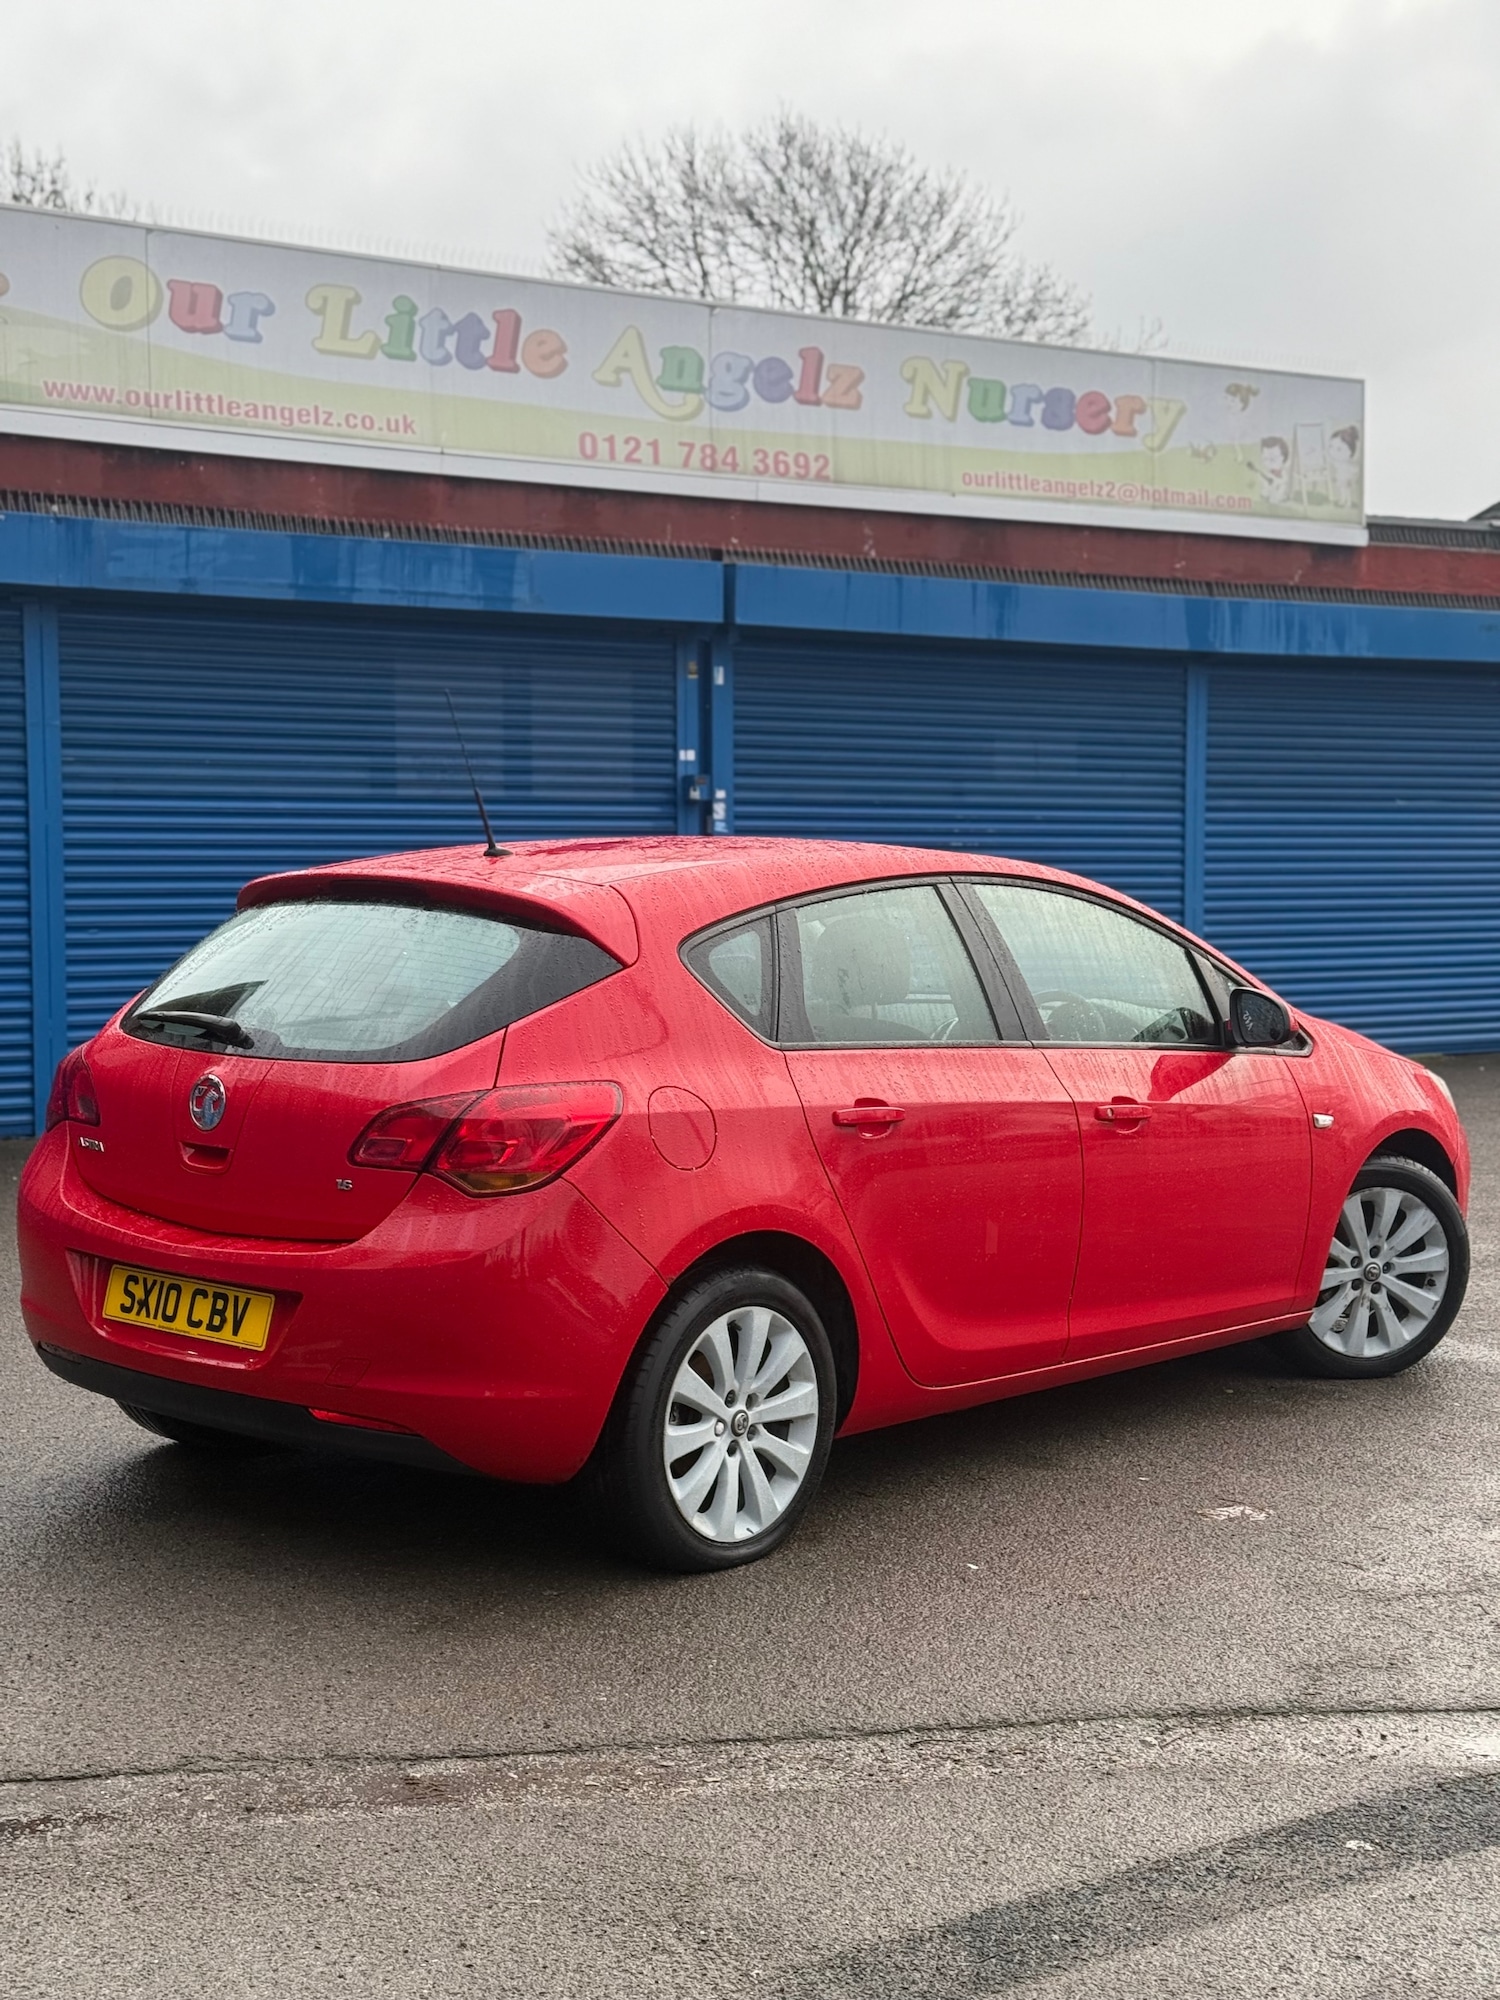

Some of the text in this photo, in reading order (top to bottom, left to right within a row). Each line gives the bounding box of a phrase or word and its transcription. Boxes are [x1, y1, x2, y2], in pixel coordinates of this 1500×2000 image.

[80, 255, 1186, 451] Our Little Angelz Nursery
[43, 378, 417, 437] www.ourlittleangelz.co.uk
[579, 432, 832, 480] 0121 784 3692
[962, 470, 1252, 510] ourlittleangelz2@hotmail.com
[120, 1274, 252, 1337] SX10 CBV
